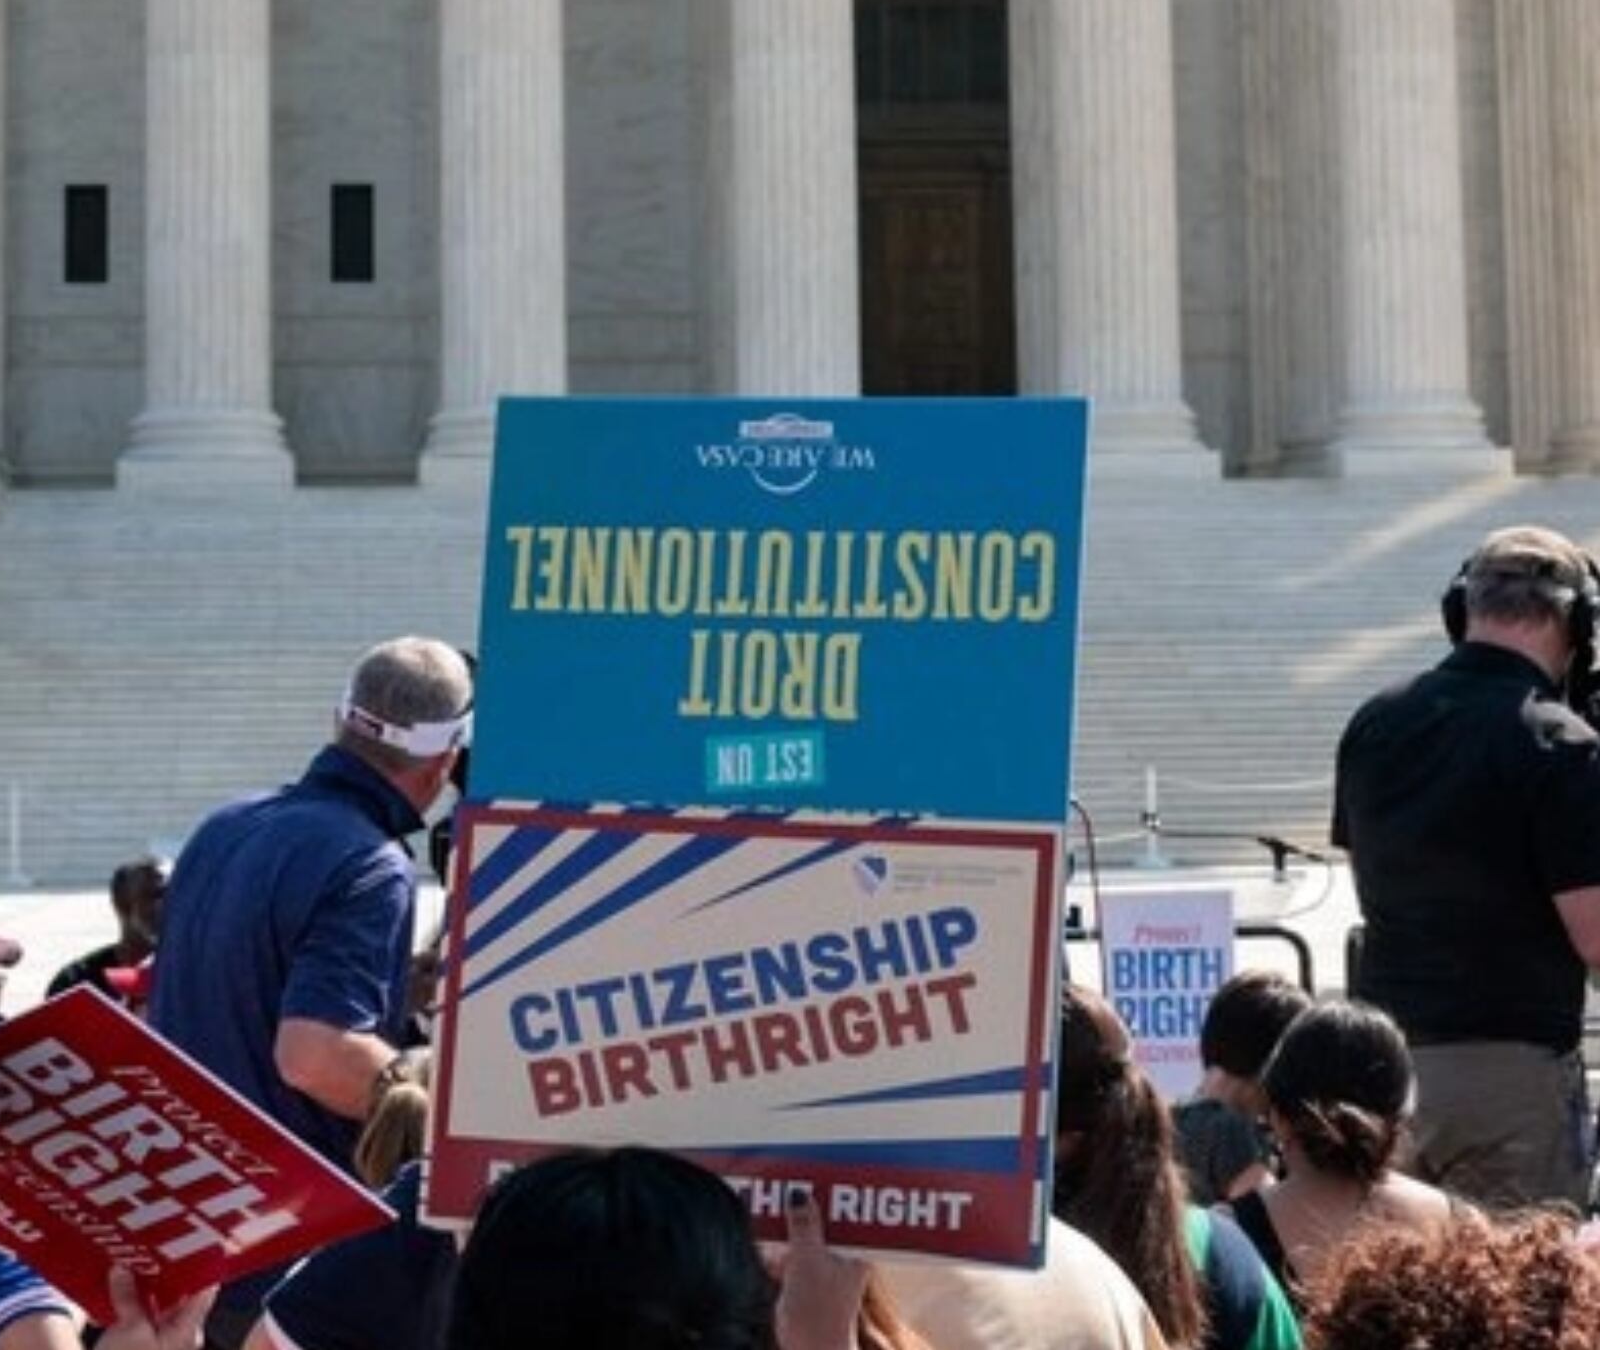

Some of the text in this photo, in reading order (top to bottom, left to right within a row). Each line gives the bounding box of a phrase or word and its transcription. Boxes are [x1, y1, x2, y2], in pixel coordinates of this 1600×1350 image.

[506, 525, 1056, 621] CONSTITUTIONNEL
[679, 629, 862, 720] DROIT
[717, 739, 814, 784] EST UN
[509, 906, 978, 1051] CITIZENSHIP
[1113, 949, 1223, 989] BIRTH
[529, 972, 977, 1117] BIRTHRIGHT
[1114, 996, 1203, 1038] RIGH
[1, 1037, 299, 1255] BIRTH
[111, 1065, 278, 1175] Protect
[831, 1183, 973, 1230] RIGHT
